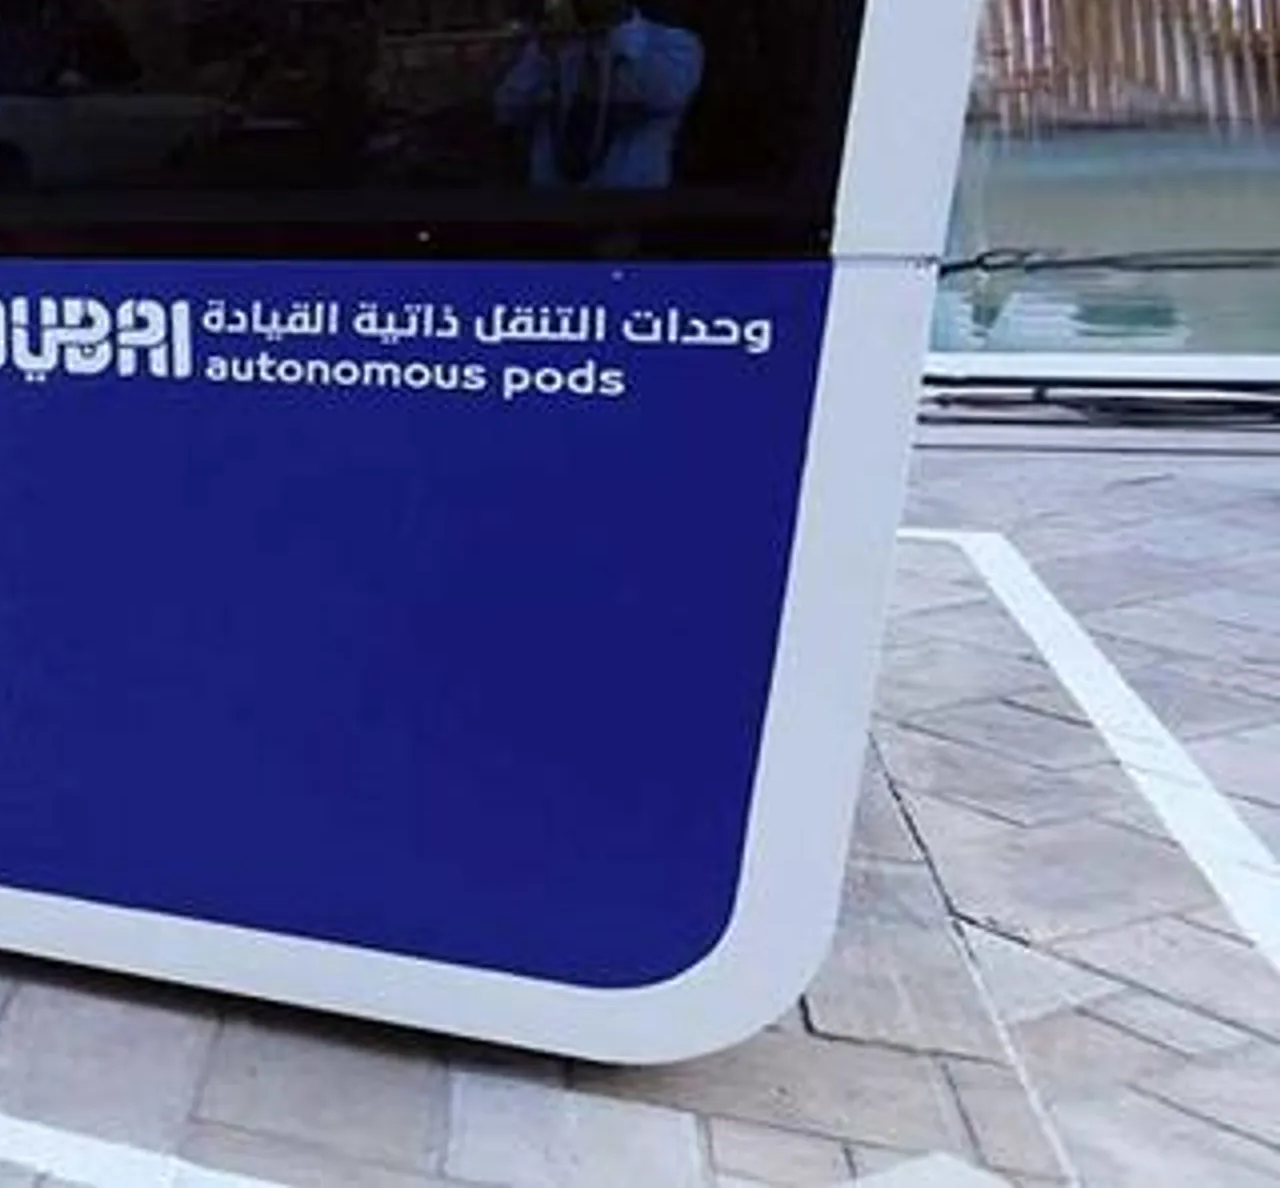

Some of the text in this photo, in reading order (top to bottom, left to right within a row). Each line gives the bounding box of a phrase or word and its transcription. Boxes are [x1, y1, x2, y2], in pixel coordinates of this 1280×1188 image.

[202, 299, 772, 353] وحدات التنقل ذاتية القيادة
[206, 351, 626, 400] autonomous pods
